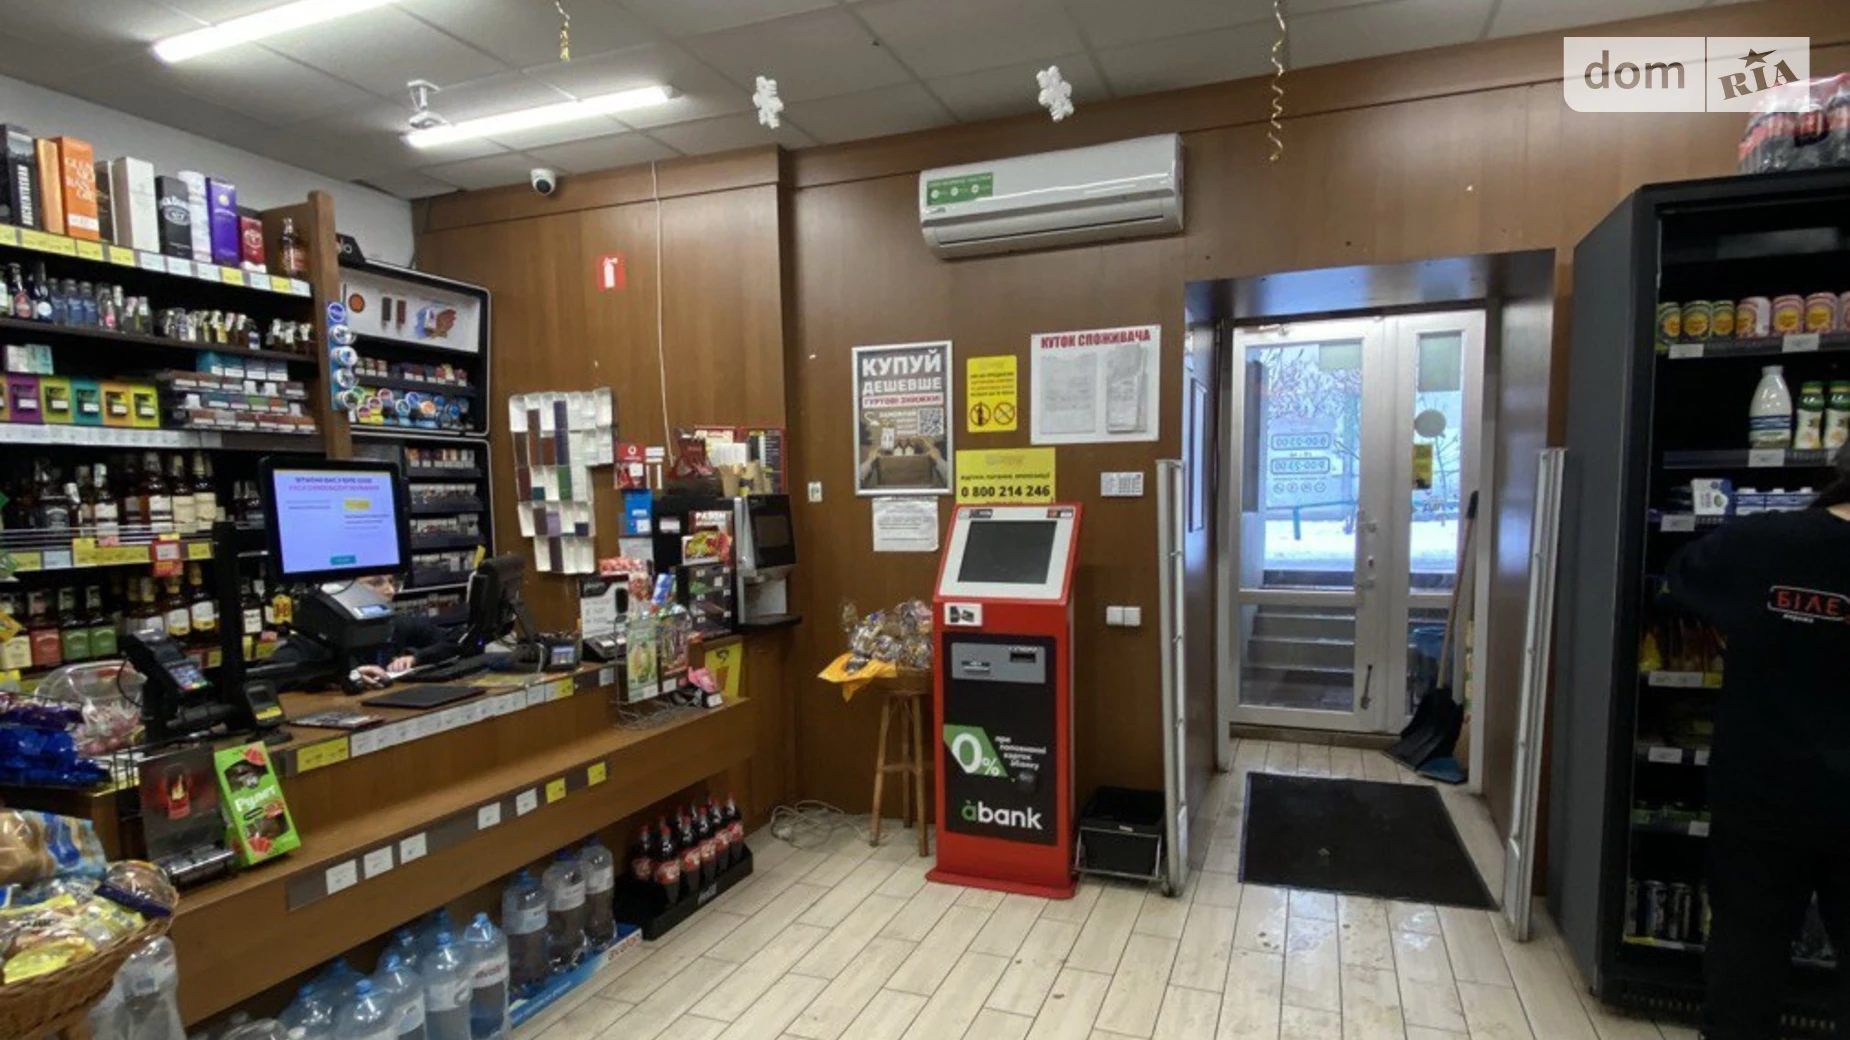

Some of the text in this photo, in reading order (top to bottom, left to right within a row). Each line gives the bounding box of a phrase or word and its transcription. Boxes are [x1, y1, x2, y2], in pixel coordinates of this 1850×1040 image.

[1040, 329, 1151, 349] КУТОК СПОЖИВАЧА
[862, 348, 941, 376] КУПУЙ
[862, 377, 942, 396] ДЕШЕВШЕ
[961, 484, 1050, 498] 0 800 214 246
[995, 736, 1011, 744] при
